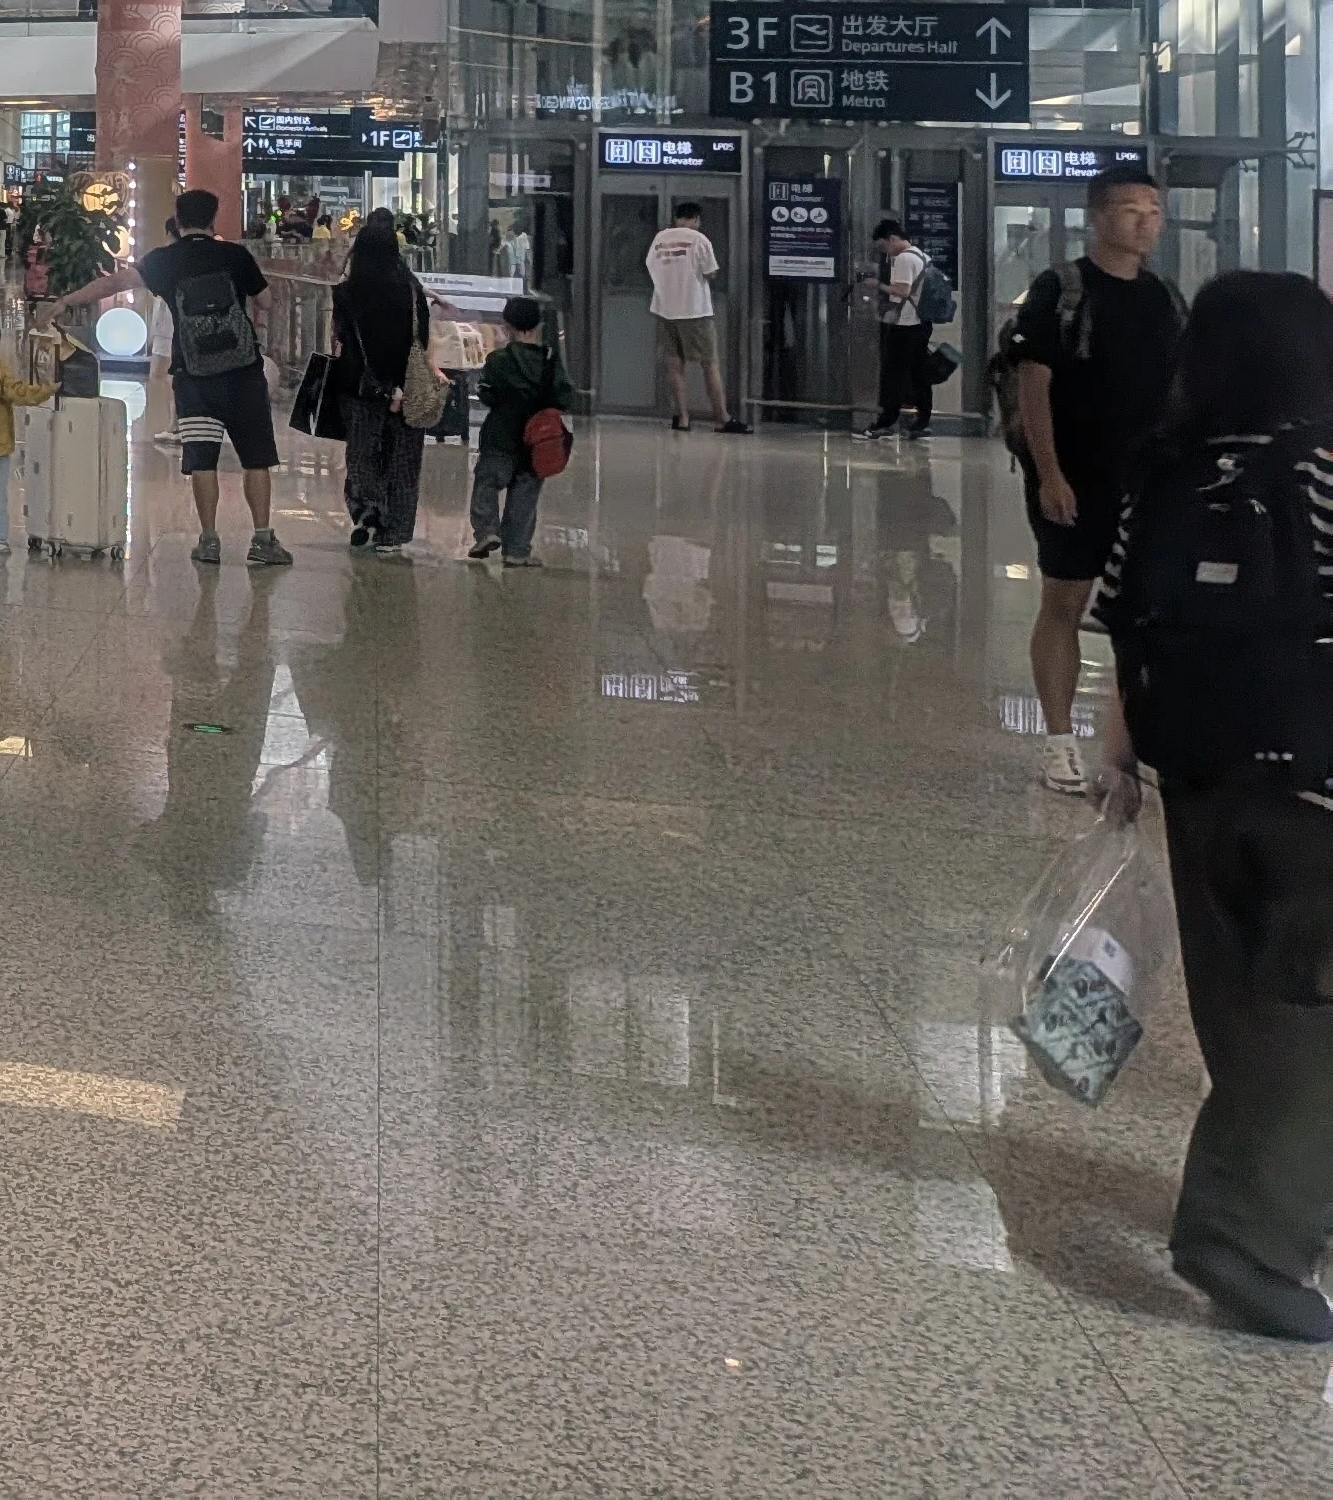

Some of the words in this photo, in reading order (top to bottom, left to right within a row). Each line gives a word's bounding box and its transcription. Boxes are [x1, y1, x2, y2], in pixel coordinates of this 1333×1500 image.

[726, 17, 778, 50] 3F
[842, 15, 939, 37] 出发大厅
[842, 39, 925, 54] Departures
[927, 41, 958, 54] Hall
[730, 71, 778, 104] B1
[841, 70, 889, 92] 地铁
[842, 95, 886, 108] Metro
[370, 131, 390, 147] 1F
[662, 141, 693, 155] 电梯
[1064, 150, 1096, 166] 电梯
